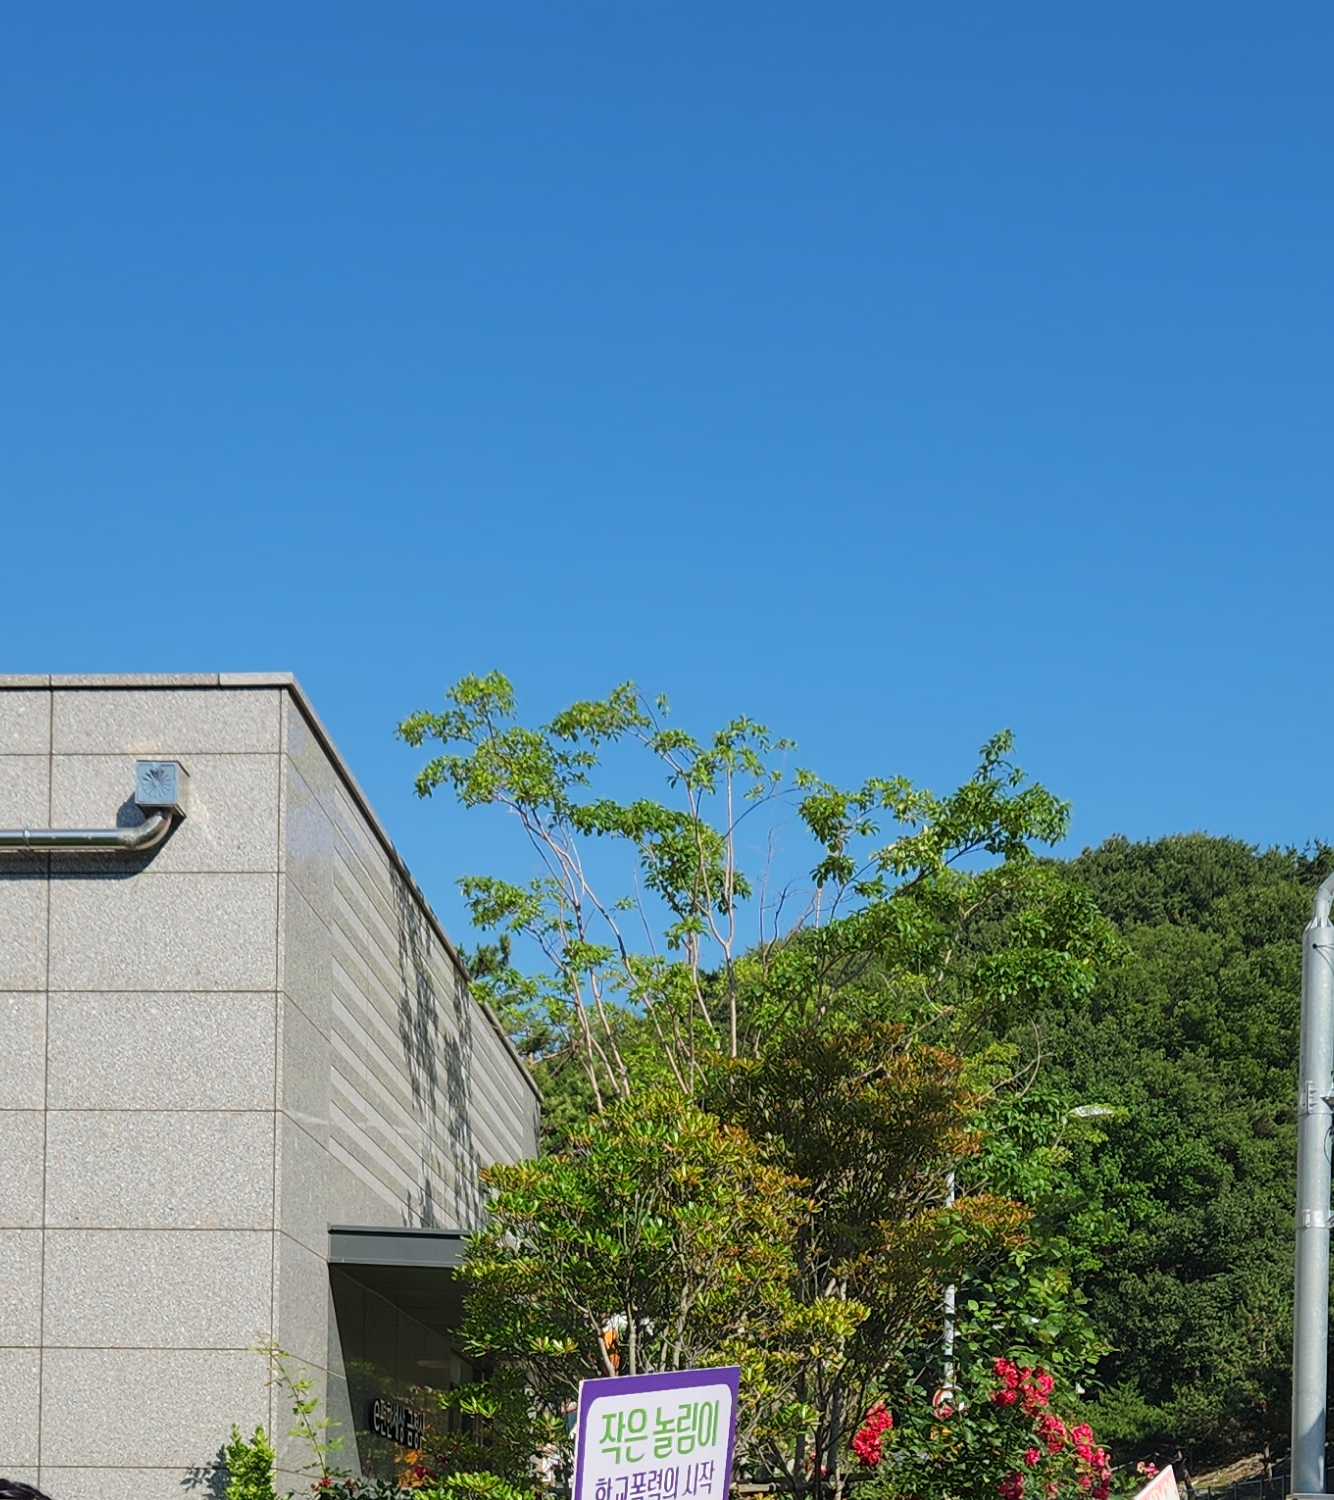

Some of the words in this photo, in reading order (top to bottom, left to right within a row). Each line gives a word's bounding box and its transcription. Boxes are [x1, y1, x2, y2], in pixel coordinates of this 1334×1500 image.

[599, 1408, 648, 1465] 작은
[653, 1400, 720, 1459] 놀림이
[682, 1460, 715, 1496] 시작
